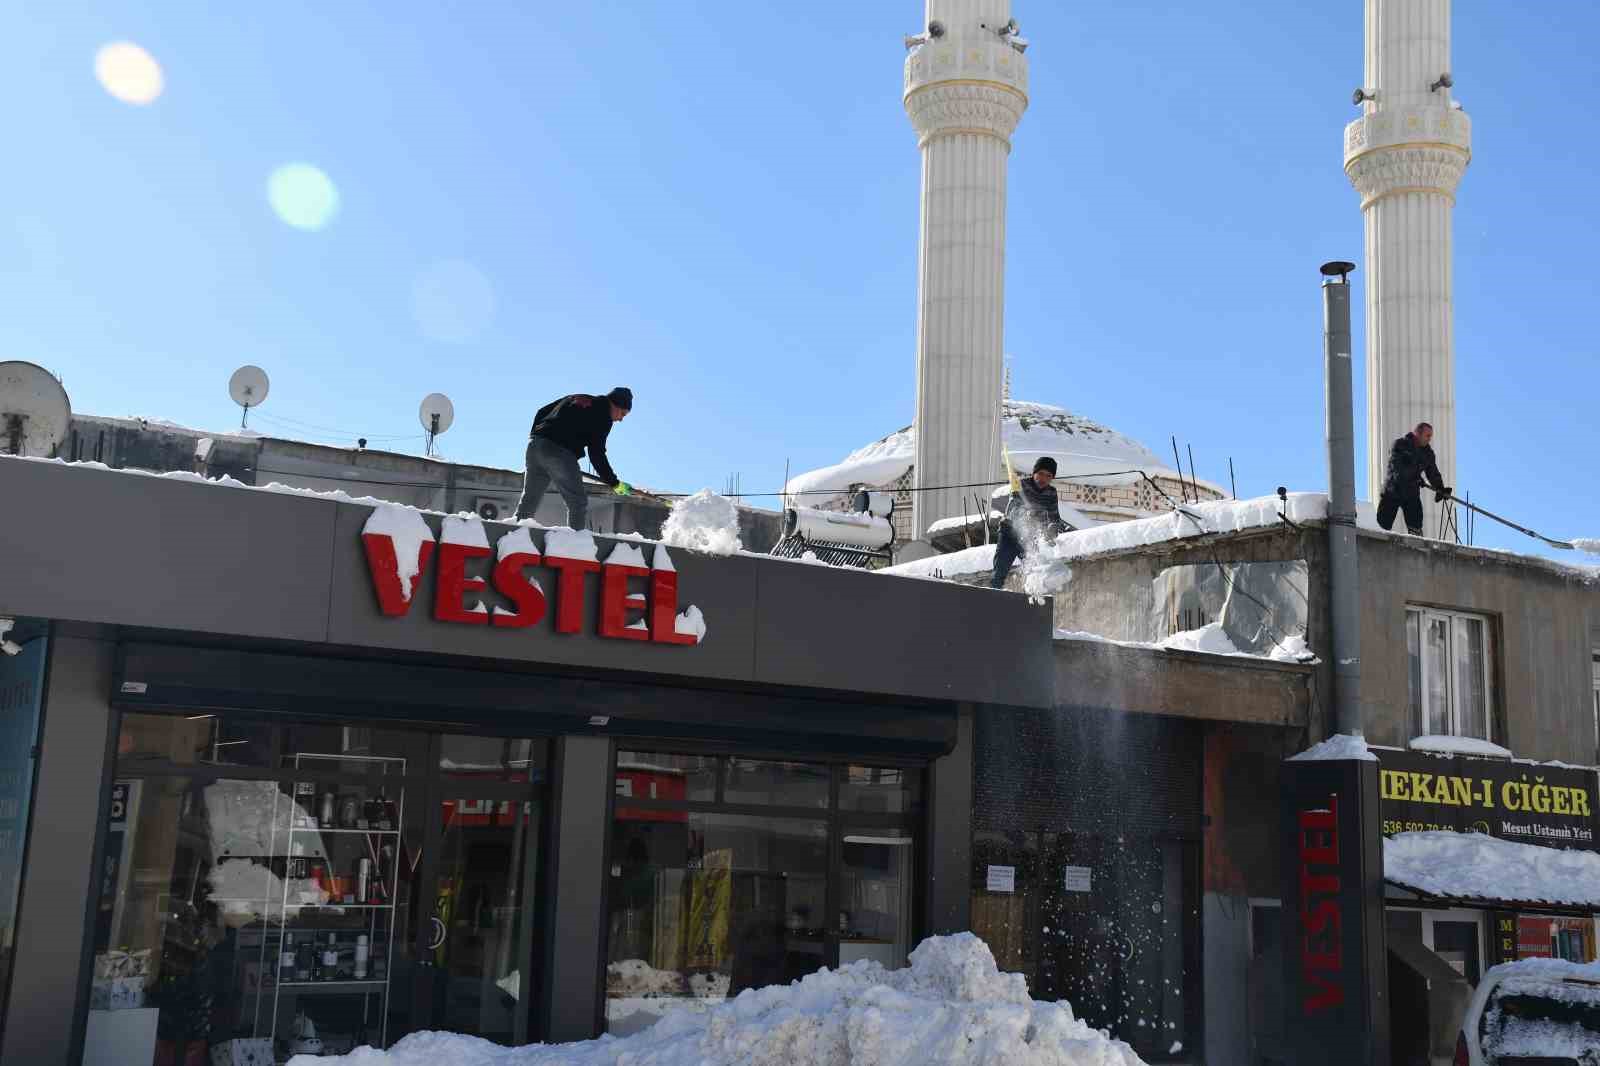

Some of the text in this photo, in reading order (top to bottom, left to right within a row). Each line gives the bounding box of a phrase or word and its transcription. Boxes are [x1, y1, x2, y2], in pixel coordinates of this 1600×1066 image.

[364, 532, 699, 645] VESTEL
[1501, 772, 1591, 817] CİĞER
[1502, 820, 1532, 834] Mesut
[1572, 827, 1593, 840] Yeri
[1299, 792, 1342, 1016] VESTEL
